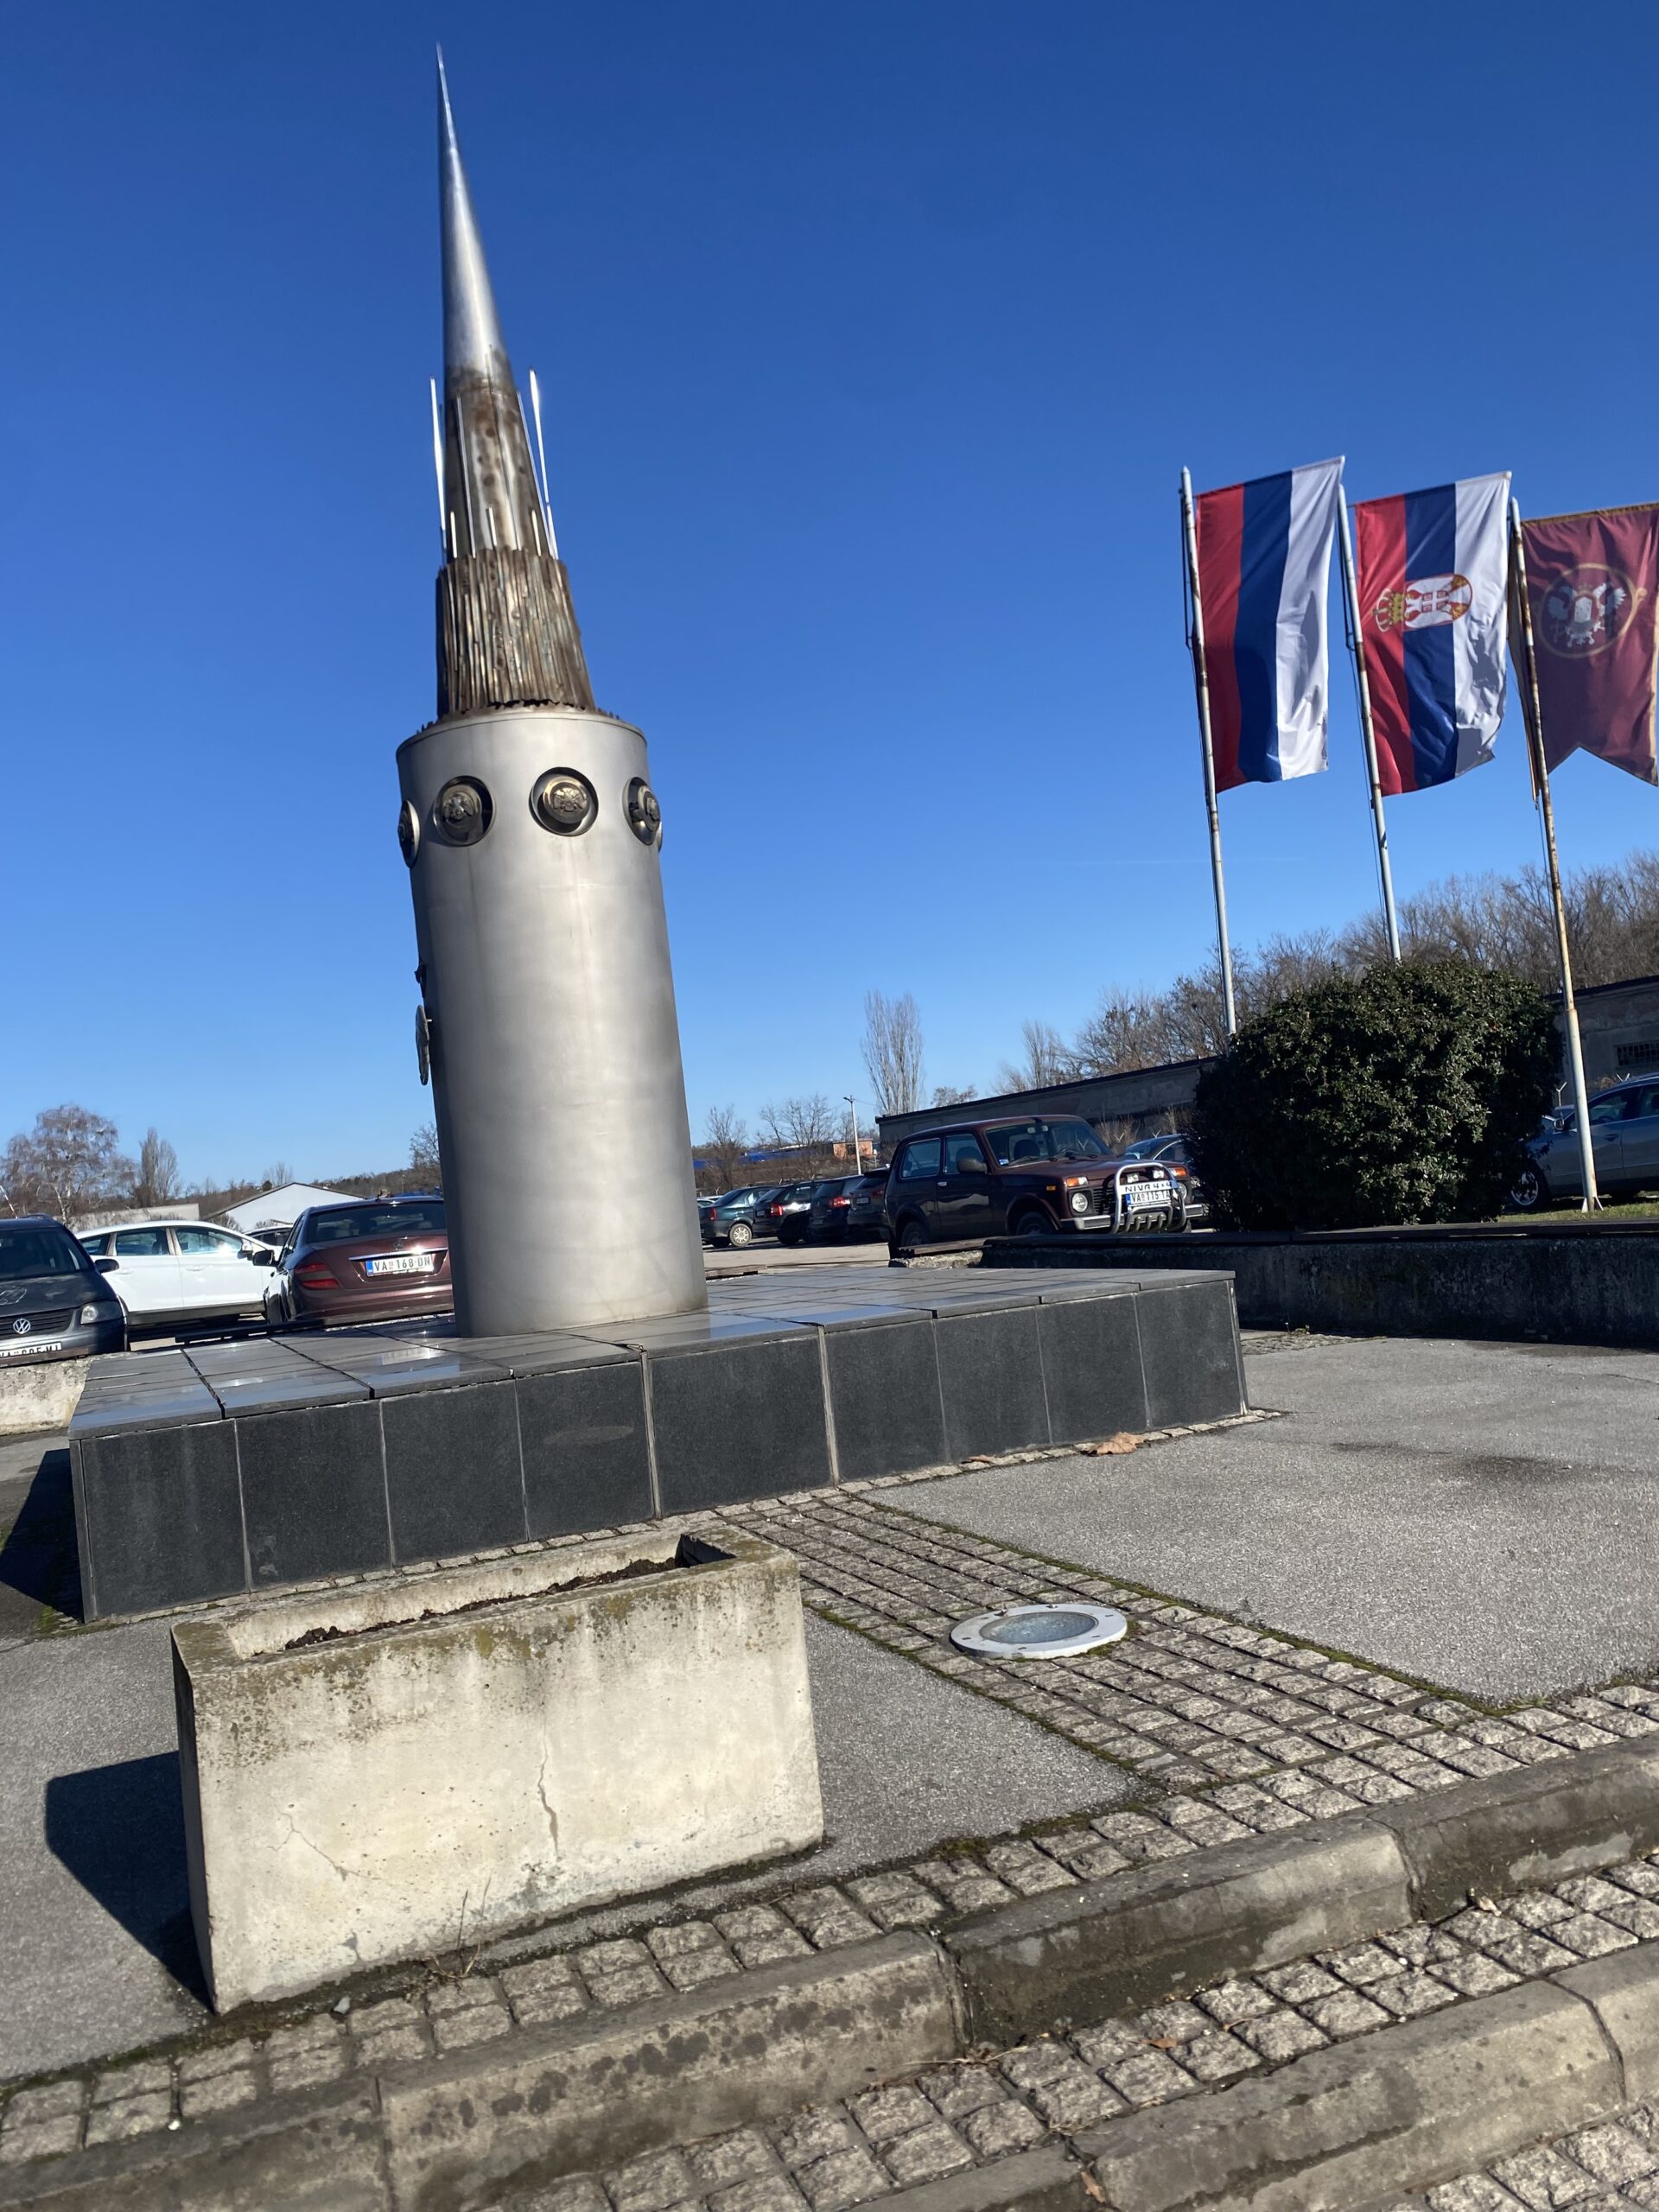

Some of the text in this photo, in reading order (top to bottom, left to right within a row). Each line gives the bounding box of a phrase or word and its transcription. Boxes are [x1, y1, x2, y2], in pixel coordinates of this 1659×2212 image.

[1125, 1184, 1150, 1192] NIVA
[1131, 1193, 1141, 1203] VA
[374, 1261, 388, 1272] VA
